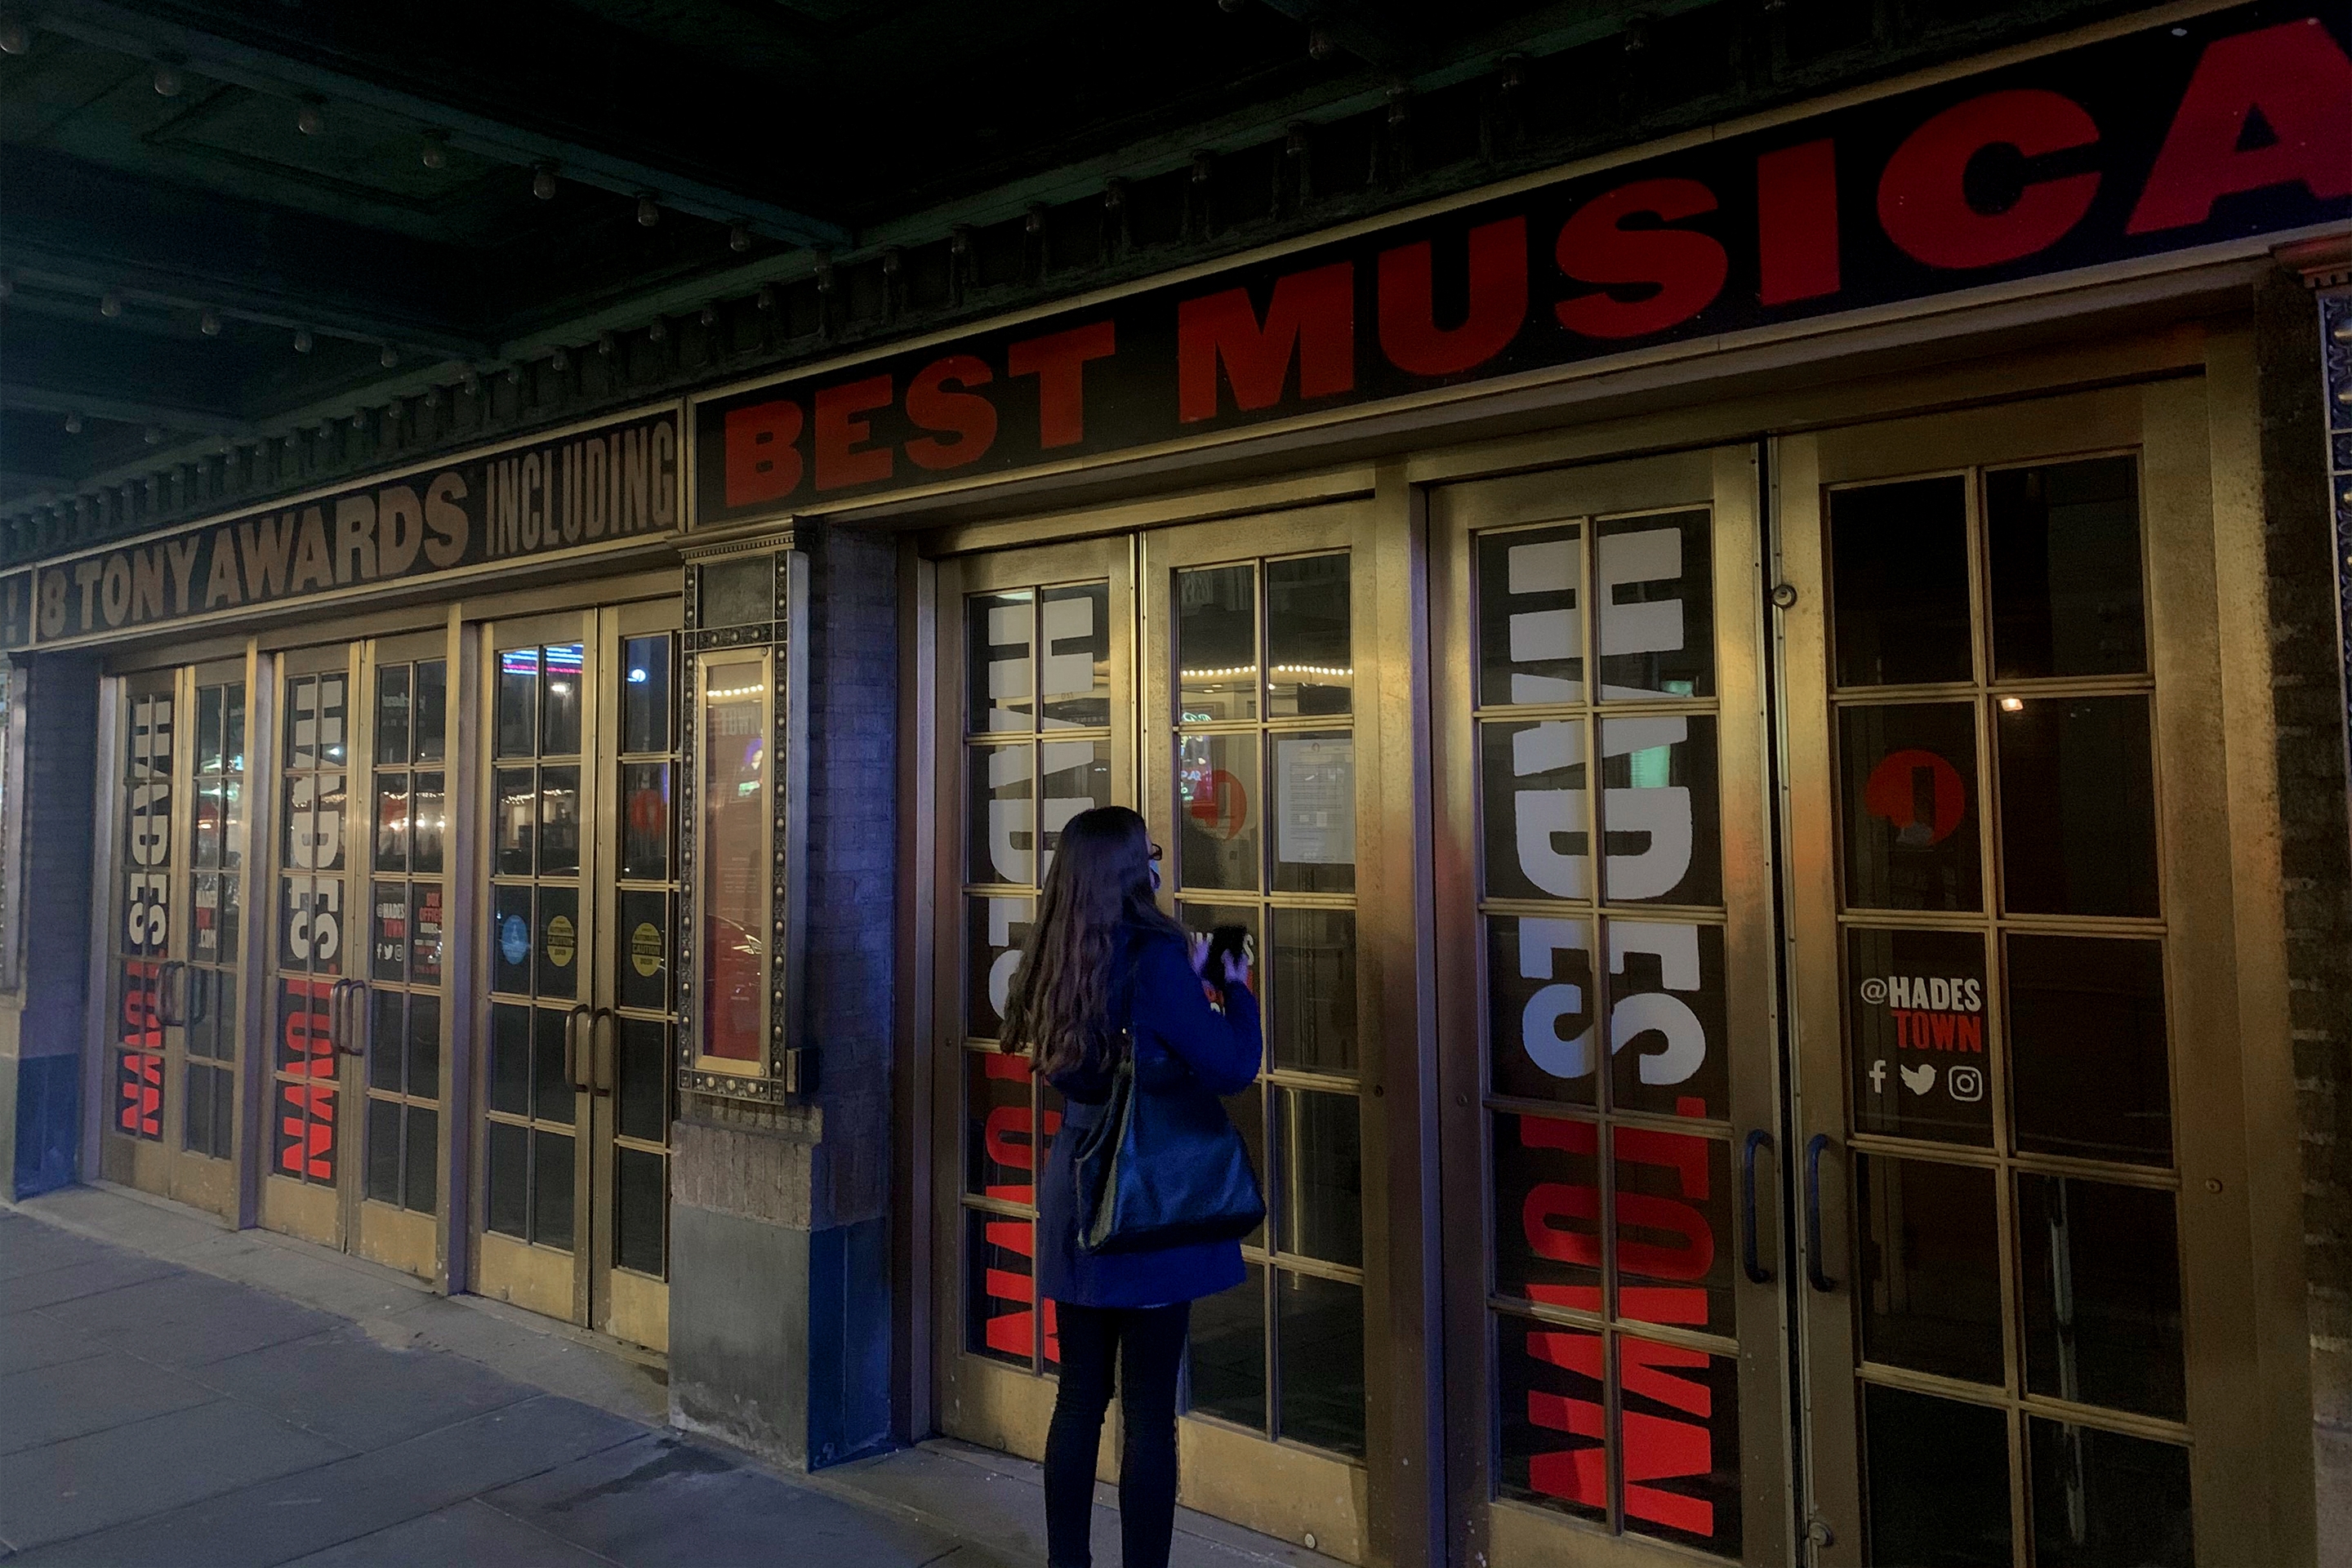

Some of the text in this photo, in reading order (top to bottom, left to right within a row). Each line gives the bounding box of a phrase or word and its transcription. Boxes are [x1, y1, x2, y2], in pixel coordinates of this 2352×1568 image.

[724, 16, 2352, 508] BEST MUSICA
[41, 419, 675, 638] 8 TONY AWARDS INCLUDING
[631, 944, 661, 956] CAUTION
[1860, 976, 1982, 1013] @HADES
[1891, 1009, 1984, 1054] TOWN
